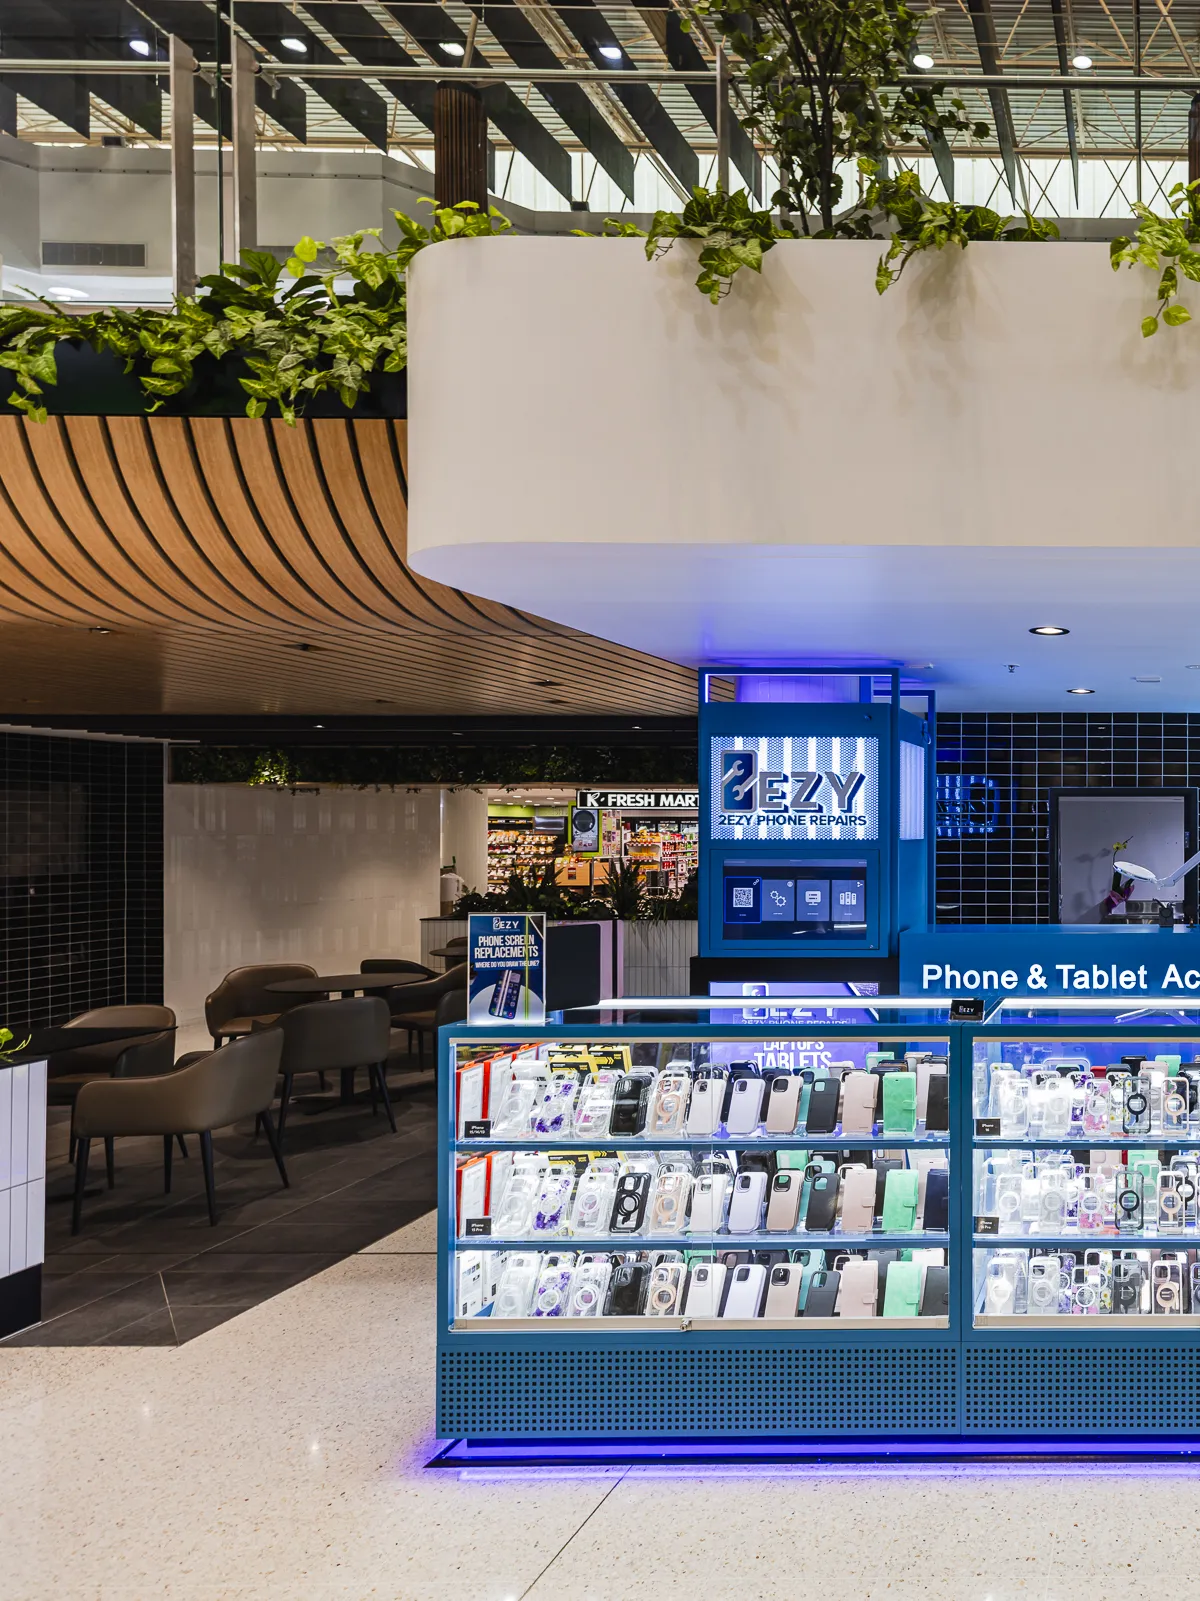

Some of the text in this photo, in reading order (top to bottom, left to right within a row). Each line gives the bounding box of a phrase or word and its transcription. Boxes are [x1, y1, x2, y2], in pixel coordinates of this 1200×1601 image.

[608, 794, 655, 807] FRESH
[718, 815, 867, 826] 2EZY PHONE REPAIRS
[478, 934, 535, 946] PHONE SCREEN
[474, 945, 538, 959] REPLACEMENTS
[922, 963, 1019, 989] Phone
[1027, 963, 1048, 989] &
[1055, 964, 1148, 989] Tablet
[754, 1052, 832, 1070] TABLETS
